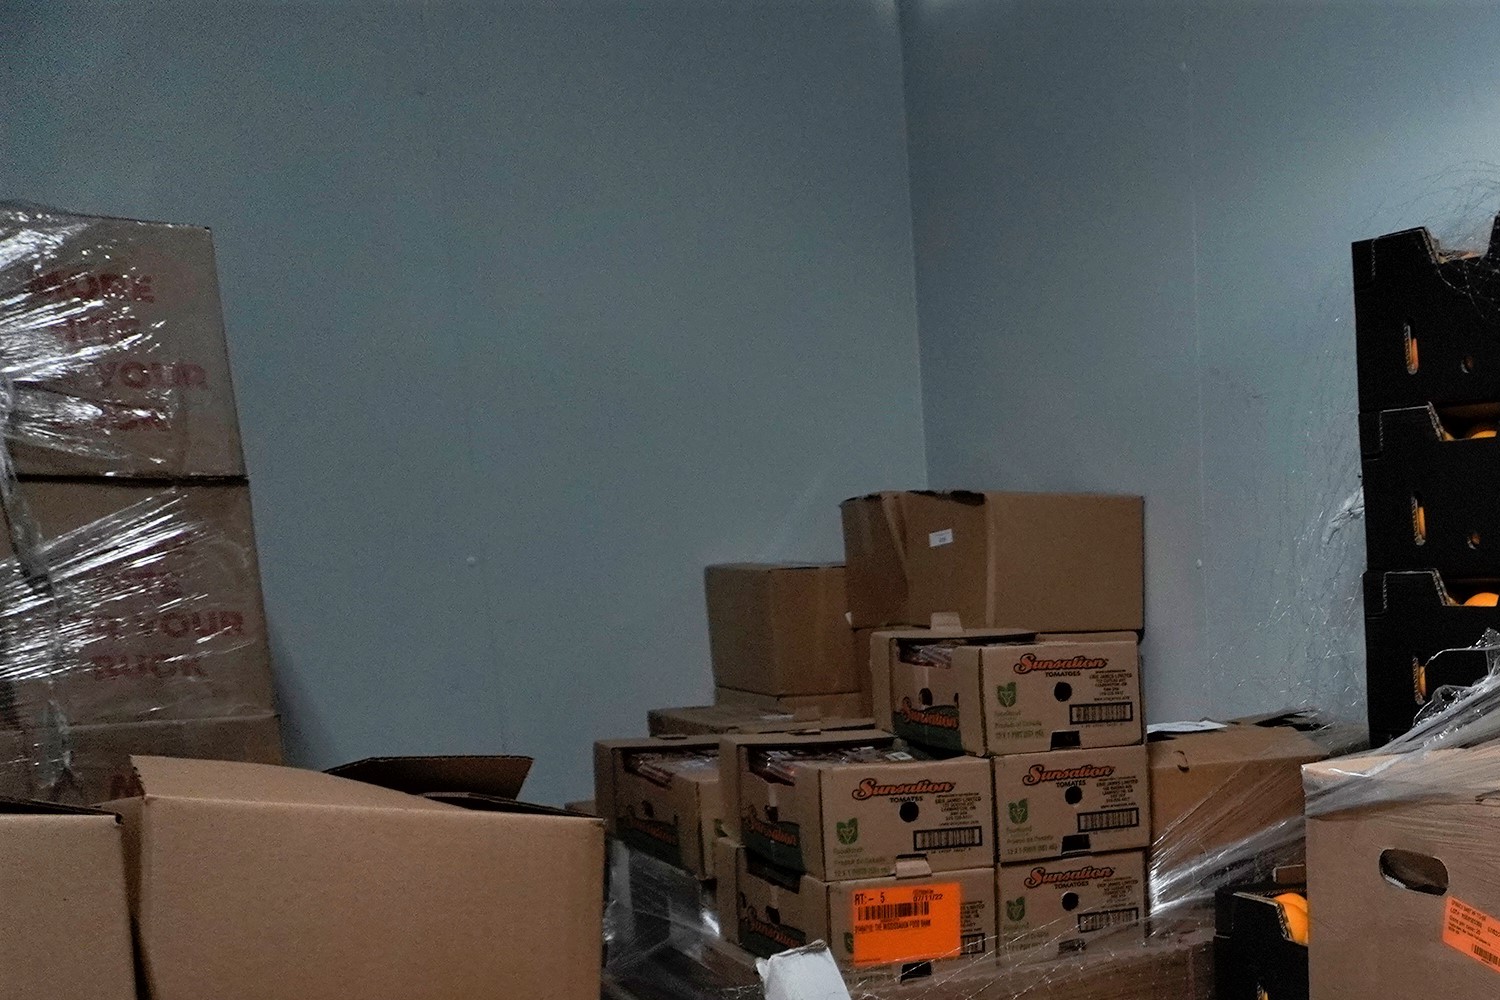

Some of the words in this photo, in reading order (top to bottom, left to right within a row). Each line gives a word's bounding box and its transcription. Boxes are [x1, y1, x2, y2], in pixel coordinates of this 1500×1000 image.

[1013, 652, 1107, 675] Sunsation
[1022, 764, 1113, 786] Sunsation
[1056, 780, 1086, 788] TOMATES
[852, 778, 955, 800] Sunsation
[1024, 865, 1114, 889] Sunsation
[1054, 881, 1089, 889] TOMATOES
[880, 891, 885, 904] 5
